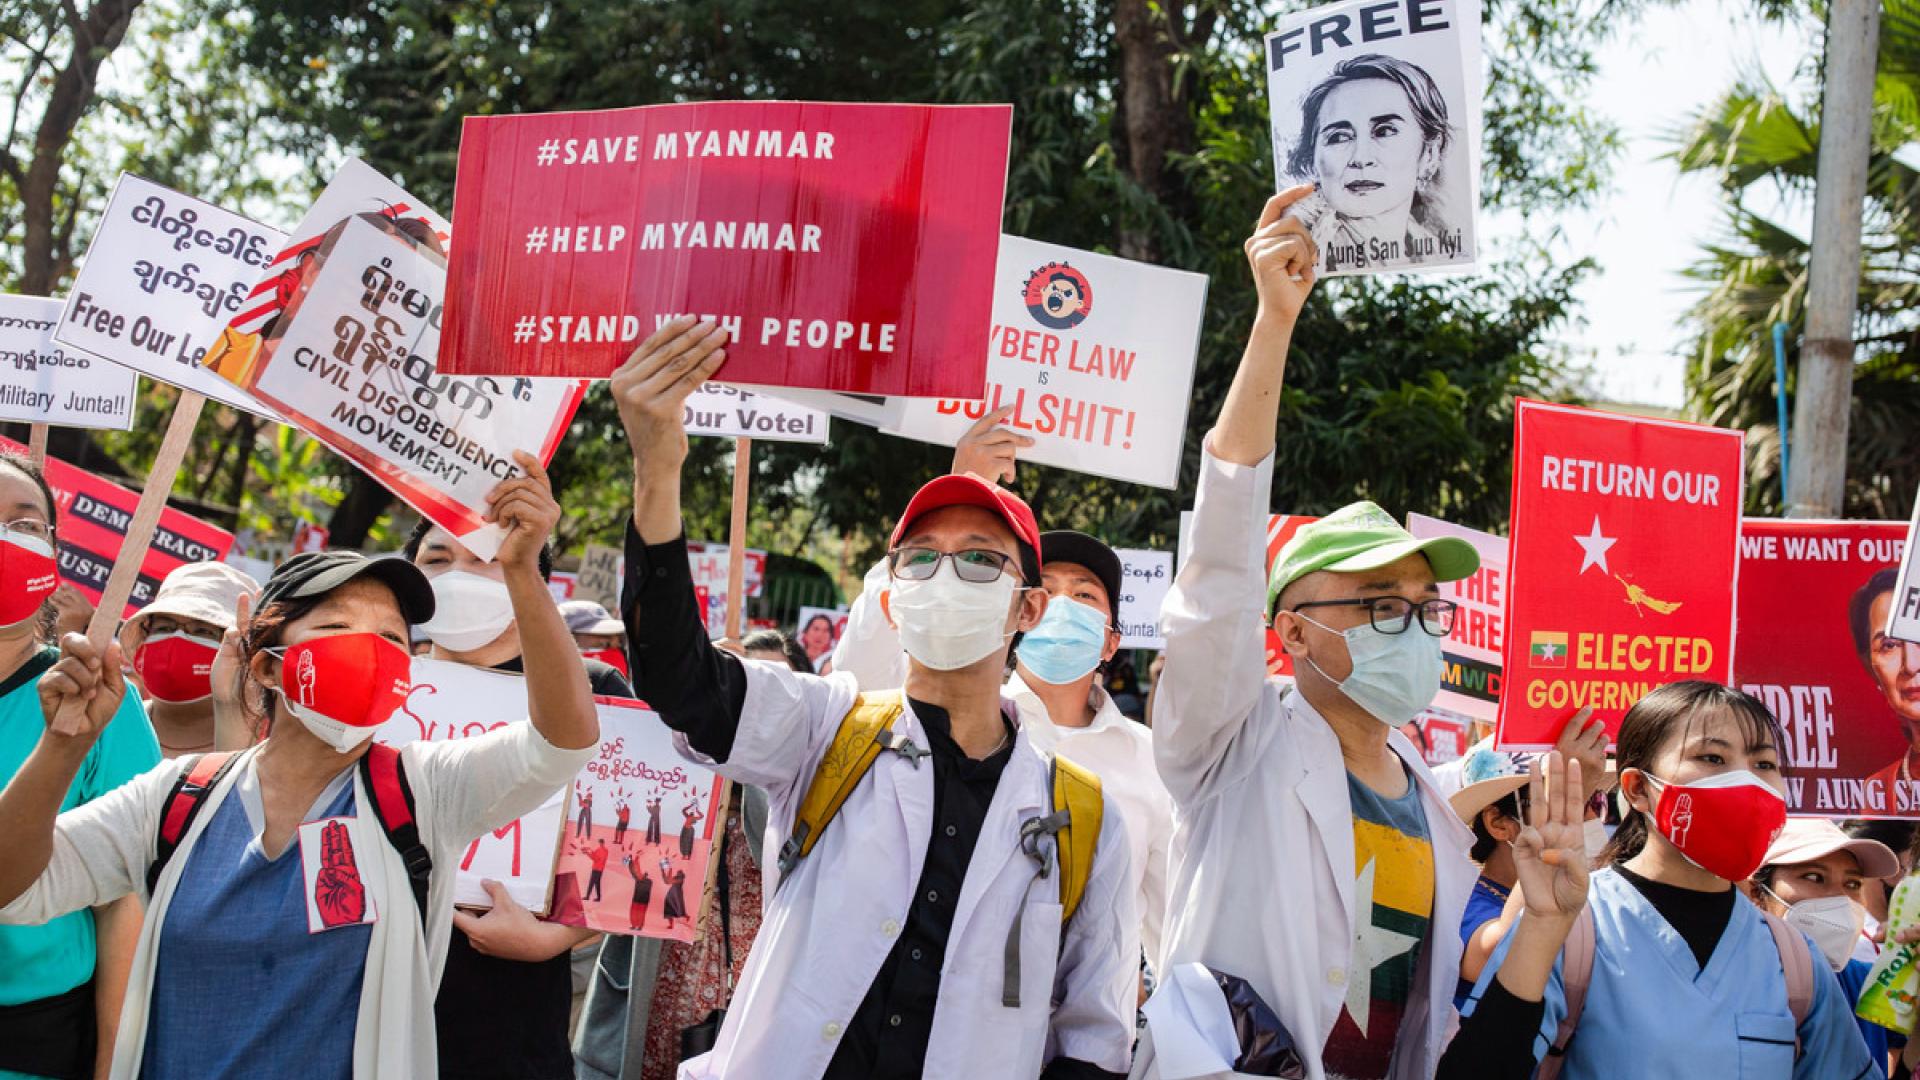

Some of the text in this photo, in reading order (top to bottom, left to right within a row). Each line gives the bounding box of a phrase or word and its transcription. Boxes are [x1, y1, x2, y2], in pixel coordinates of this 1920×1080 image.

[1270, 0, 1449, 71] FREE
[537, 130, 835, 166] #SAVE MYANMAR
[526, 220, 822, 254] #HELP MYANMAR
[1369, 236, 1399, 261] San
[1439, 227, 1463, 259] Kyi
[70, 291, 125, 338] Free
[130, 315, 175, 357] Our
[513, 314, 639, 344] #STAND
[761, 319, 896, 353] PEOPLE
[293, 347, 349, 392] CIVIL
[1038, 371, 1049, 385] IS
[1068, 339, 1136, 382] LAW
[63, 391, 125, 415] Junta!!
[331, 401, 468, 486] MOVEMENT
[1541, 455, 1720, 506] RETURN OUR
[74, 494, 217, 563] DEMRACY
[1741, 536, 1777, 560] WE
[1784, 538, 1850, 562] WANT
[57, 550, 151, 601] USTE
[1446, 604, 1501, 652] ARE
[1577, 632, 1713, 674] ELECTED
[1816, 777, 1886, 810] AUNG
